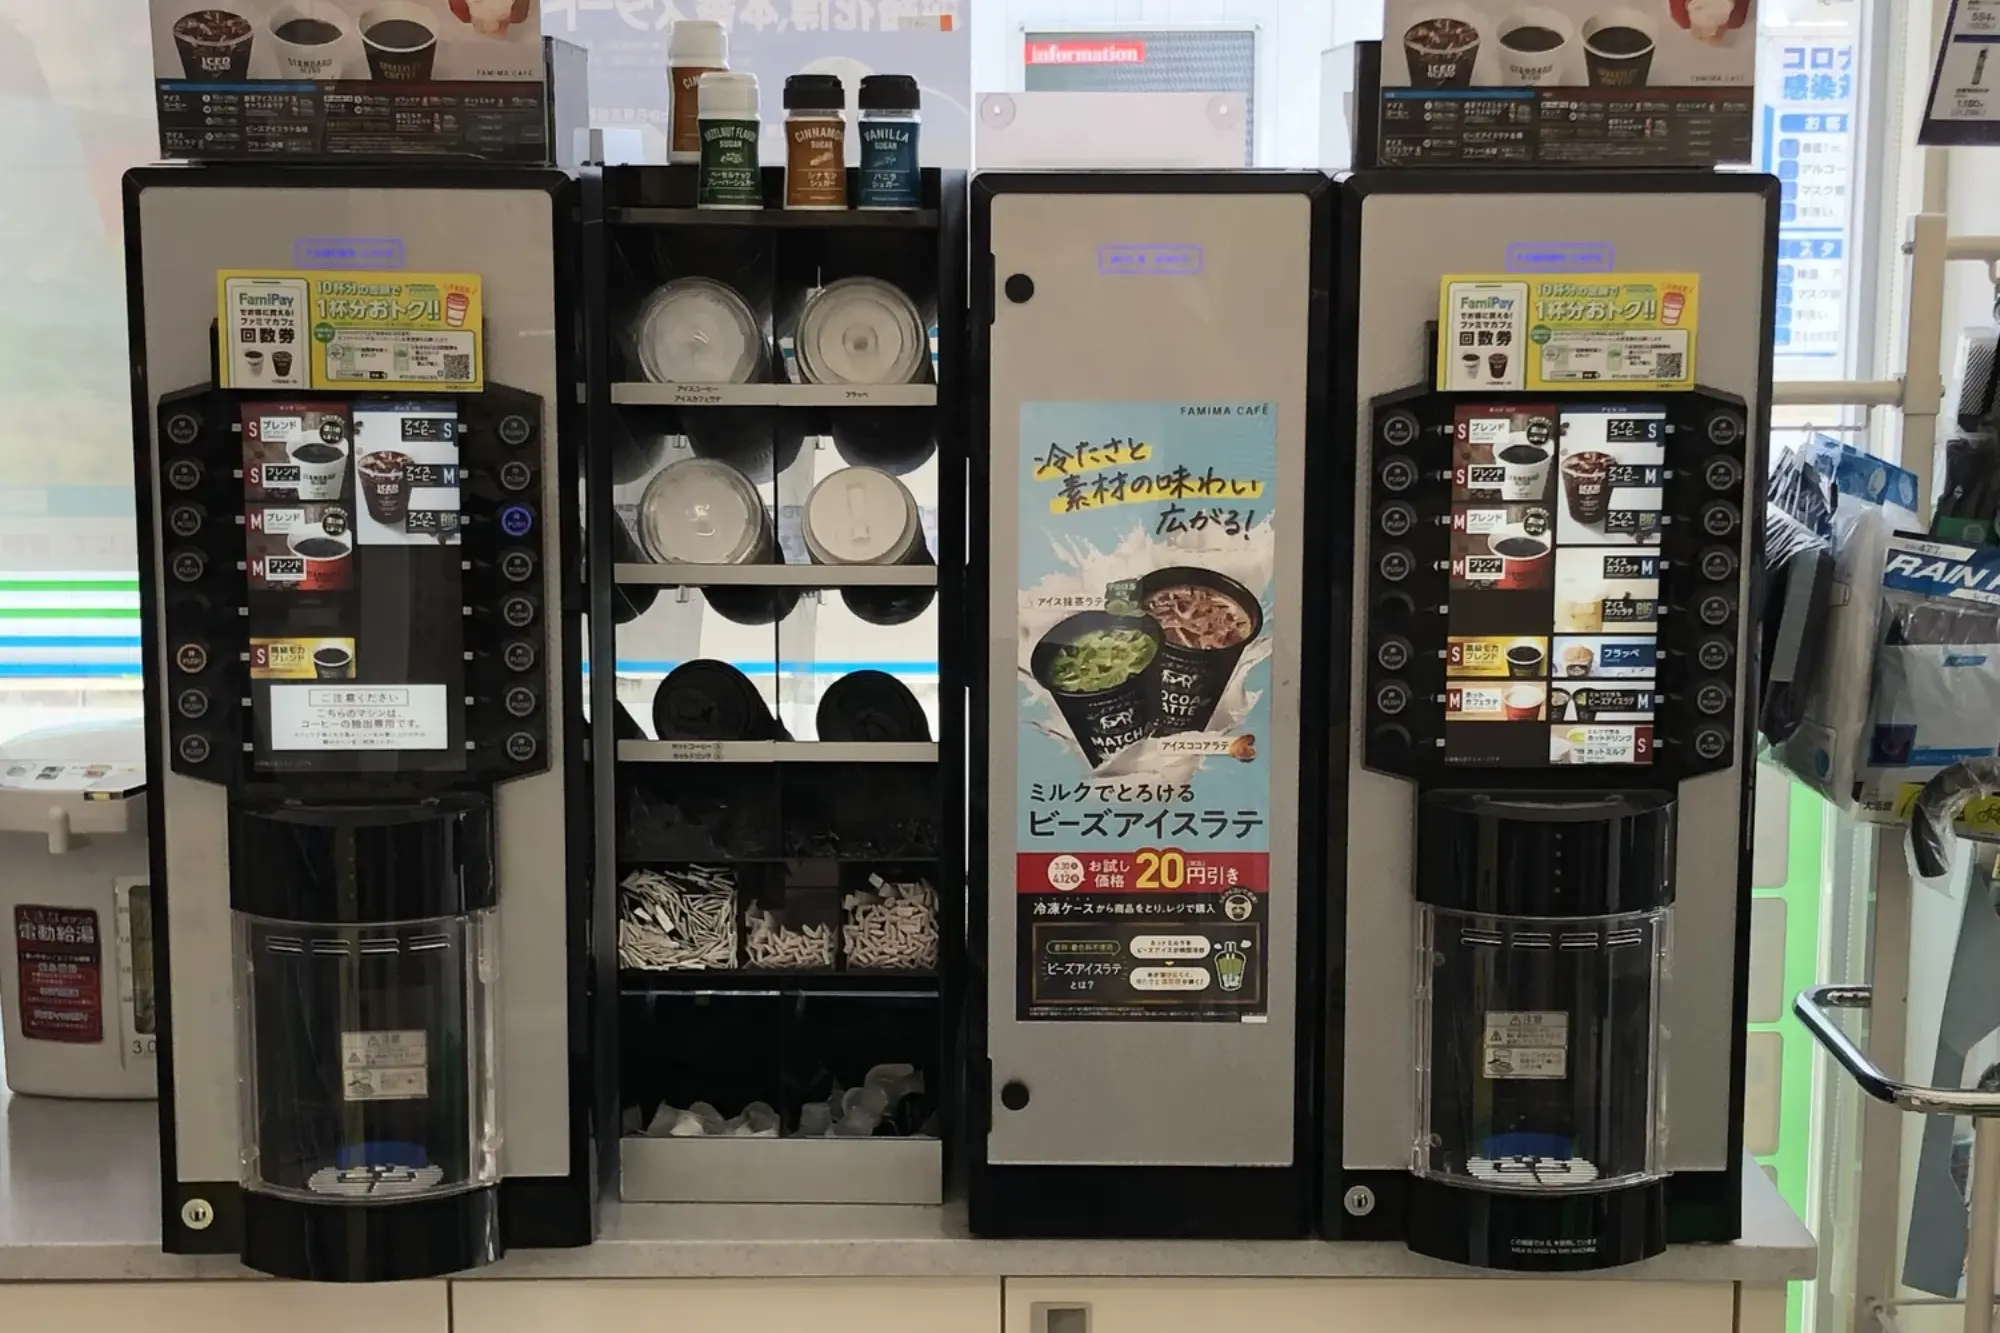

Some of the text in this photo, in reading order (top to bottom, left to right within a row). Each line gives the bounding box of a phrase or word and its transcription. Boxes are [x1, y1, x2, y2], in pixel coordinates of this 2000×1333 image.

[794, 127, 844, 142] CINNAMO
[864, 129, 909, 143] VANILLA
[720, 140, 742, 148] SUGAR
[811, 141, 833, 149] SUGAR
[874, 142, 898, 150] SUGAR
[807, 172, 837, 180] シナモン
[810, 180, 836, 188] シュガー
[239, 292, 294, 307] FamiPay
[1460, 297, 1514, 310] FamiPay
[240, 318, 295, 326] ファミマカフェ
[1460, 321, 1513, 329] ファミマカフェ
[240, 328, 295, 344] 回数券
[1459, 331, 1513, 347] 回数券
[845, 390, 870, 398] フラッペ
[1180, 403, 1269, 416] FAMIMA CAFÉ
[249, 420, 297, 437] S ブレンド
[404, 420, 430, 428] アイス
[404, 423, 452, 438] コーヒー S
[1457, 423, 1505, 440] S ブレンド
[1609, 423, 1657, 439] コーヒー S
[1610, 421, 1635, 429] アイス
[1034, 437, 1147, 476] 冷たさと
[251, 467, 299, 483] S ブレンド
[406, 466, 431, 474] アイス
[443, 469, 455, 484] M
[1456, 468, 1503, 485] S ブレンド
[1645, 469, 1656, 484] M
[1058, 464, 1258, 512] 素材の味わい
[251, 513, 301, 530] M ブレンド
[409, 512, 433, 520] アイス
[440, 513, 458, 527] BIG
[1156, 502, 1255, 541] 広がる!
[1454, 513, 1503, 530] M ブレンド
[1608, 512, 1633, 520] アイス
[1639, 513, 1656, 526] BIG
[252, 560, 302, 576] M ブレンド
[1453, 560, 1502, 576] M ブレンド
[1606, 558, 1627, 566] アイス
[1606, 560, 1653, 576] カフェラテ M
[1885, 553, 1990, 587] RAIN
[1605, 601, 1624, 609] アイス
[256, 648, 266, 664] S
[1451, 647, 1461, 662] S
[1603, 649, 1640, 658] フラッペ
[1450, 693, 1460, 708] M
[1637, 693, 1649, 709] M
[317, 708, 402, 718] こちらのマシンは、
[1161, 741, 1230, 751] アイスココアラテ
[1586, 737, 1646, 756] ホットミルク S
[1030, 782, 1196, 803] ミルクでとろける
[1030, 807, 1264, 839] ビーズアイスラテ
[1088, 860, 1130, 872] お試し
[1135, 852, 1239, 889] 20 円引き
[1094, 874, 1125, 888] 価格
[19, 922, 95, 943] 電動給湯
[1047, 962, 1122, 976] ビーズアイスラテ
[1069, 980, 1094, 990] とは?
